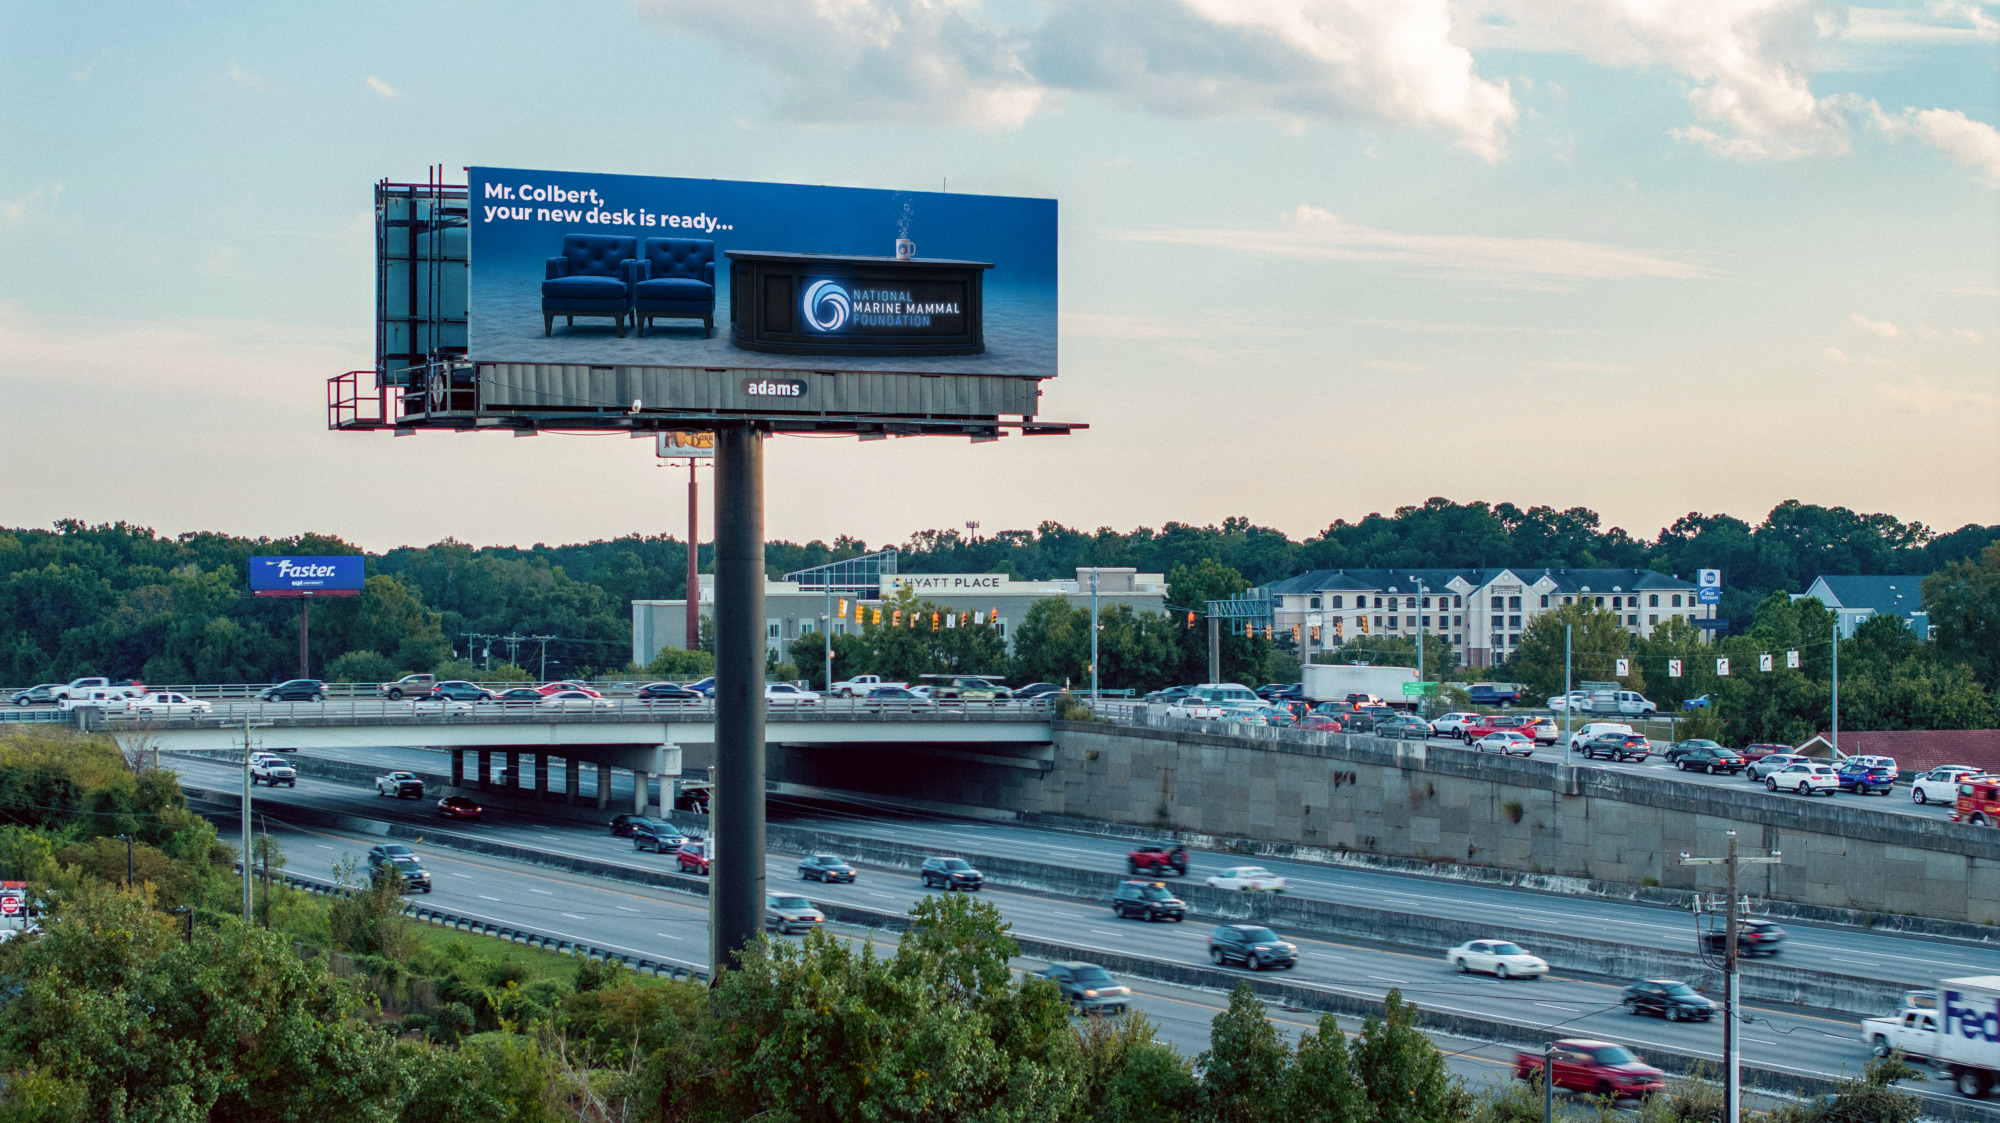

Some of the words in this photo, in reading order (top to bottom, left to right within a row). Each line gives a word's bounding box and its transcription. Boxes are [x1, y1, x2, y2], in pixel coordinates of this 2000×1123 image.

[484, 182, 516, 200] Mr.
[518, 184, 604, 208] Colbert,
[484, 205, 532, 223] your
[537, 208, 583, 222] new
[585, 207, 636, 226] desk
[639, 208, 656, 227] is
[660, 212, 734, 233] ready...
[853, 289, 913, 302] NATIONAL
[853, 302, 902, 314] MARINE
[906, 302, 960, 314] MAMMAL
[853, 314, 931, 327] FOUNDATION
[748, 380, 800, 396] adams
[277, 560, 336, 578] Faster.
[904, 578, 948, 587] HYATT
[955, 578, 999, 587] PLACE
